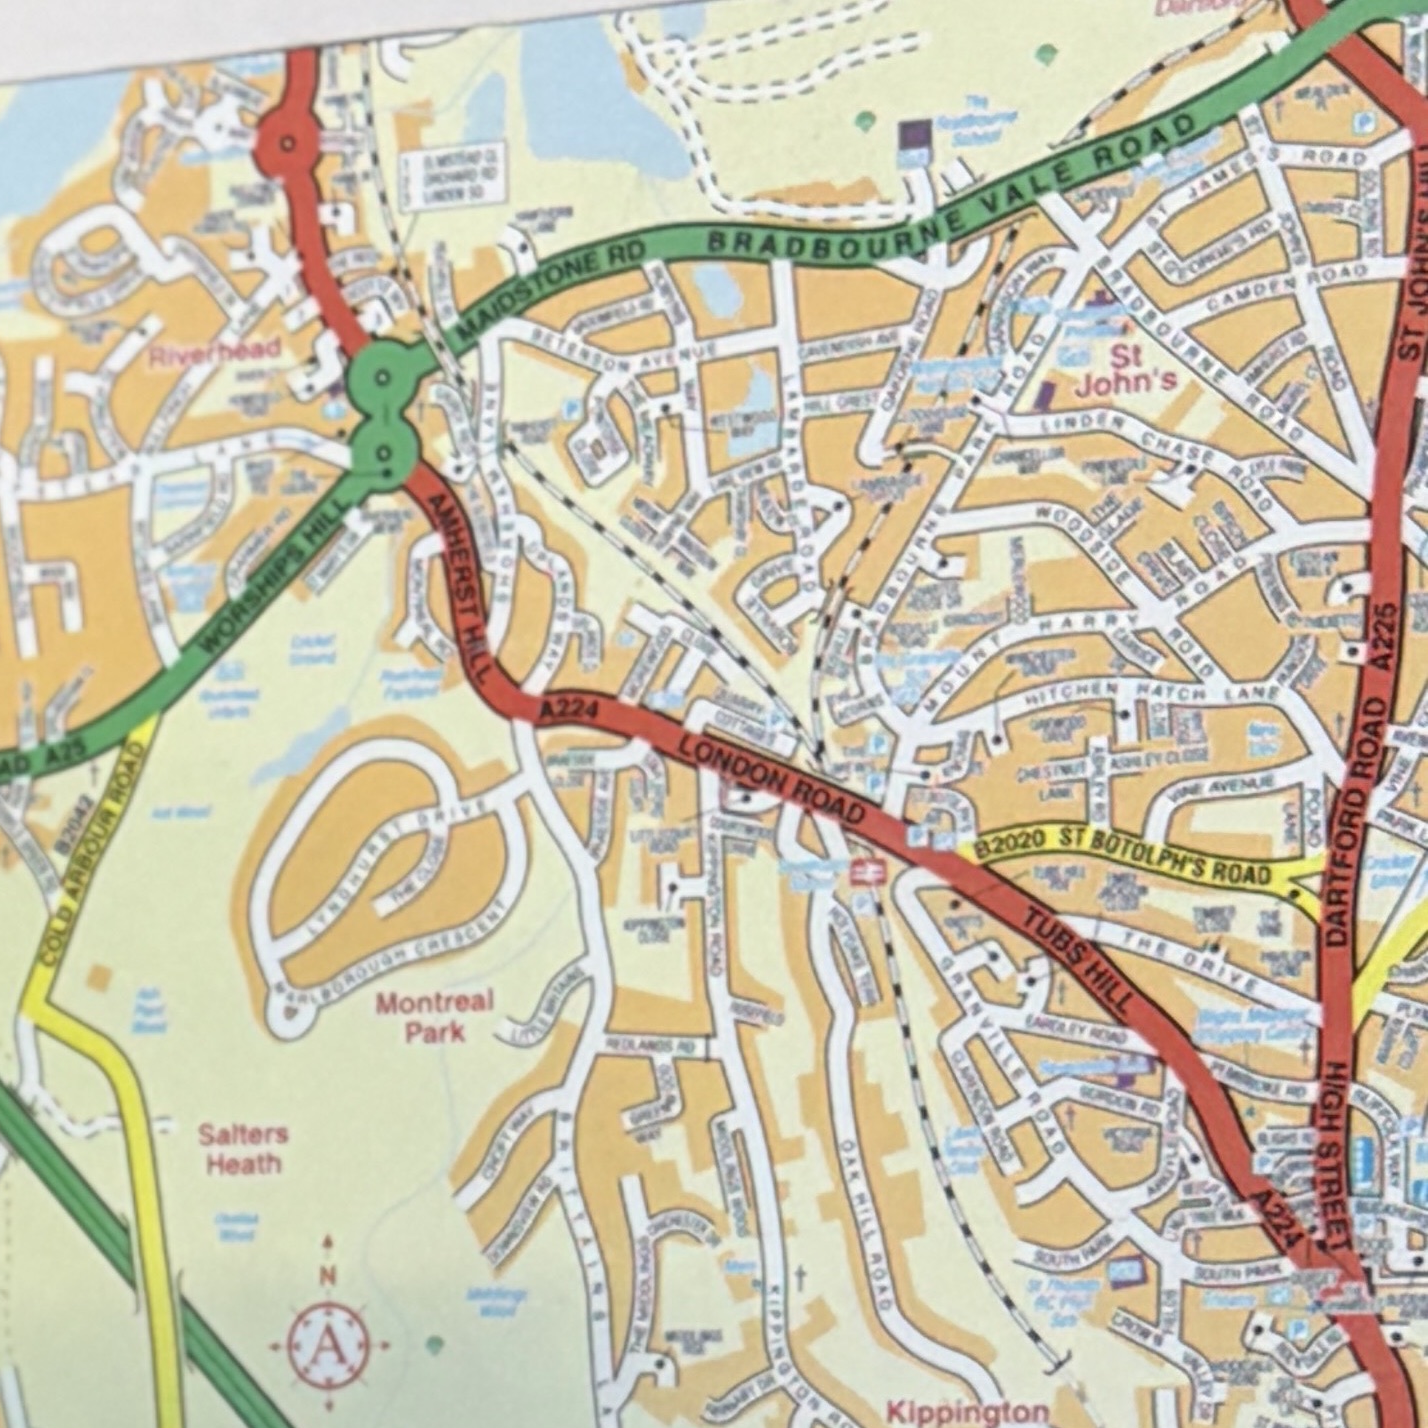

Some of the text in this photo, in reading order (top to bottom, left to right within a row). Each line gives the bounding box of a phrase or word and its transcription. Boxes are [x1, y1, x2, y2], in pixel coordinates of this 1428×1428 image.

[705, 112, 1197, 262] BRADBOURNE VALE ROAD
[1302, 149, 1368, 165] ROAD
[456, 249, 603, 344] MAIDSTONE
[607, 239, 648, 267] RD
[914, 288, 939, 335] ROAD
[1206, 264, 1369, 312] CAMDEN ROAD
[148, 337, 282, 368] Riverhead
[640, 341, 718, 369] AVENUE
[1096, 255, 1228, 384] BRADBOURNE
[1245, 392, 1305, 442] ROAD
[1109, 343, 1143, 369] St
[1321, 345, 1347, 392] ROAD
[1397, 325, 1423, 362] ST
[955, 421, 993, 480] PARK
[1002, 333, 1047, 398] ROAD
[1075, 366, 1179, 397] John's
[1041, 414, 1273, 512] LINDEN CHASE ROAD
[199, 540, 306, 655] WORSHIPS
[303, 498, 350, 548] HILL
[429, 493, 492, 688] AMHERST HILL
[1036, 506, 1214, 678] WOODSIDE ROAD
[924, 633, 1003, 714] MOUNT
[1040, 612, 1138, 632] HARRY
[1177, 555, 1247, 608] ROAD
[1369, 601, 1399, 671] A225
[539, 696, 600, 723] A224
[1025, 682, 1280, 705] HITCHEN HATCH LANE
[44, 738, 88, 767] A25
[677, 734, 867, 826] LONDON ROAD
[1208, 774, 1276, 793] AVENUE
[1324, 696, 1387, 949] DARTFORD ROAD
[39, 740, 145, 968] COLD ARBOUR ROAD
[305, 799, 488, 937] LYNDHURST DRIVE
[974, 826, 1272, 886] B2020 ST BOTOLPH'S ROAD
[272, 898, 507, 1006] MARLBOROUGH CRESCENT
[1022, 905, 1133, 1015] TUBS HILL
[1122, 932, 1258, 996] THE DRIVE
[375, 989, 494, 1015] Montreal
[404, 1018, 466, 1044] Park
[942, 955, 1066, 1155] GRANVILLE ROAD
[1089, 1026, 1128, 1044] ROAD
[198, 1123, 289, 1147] Salters
[205, 1152, 283, 1177] Heath
[1316, 1060, 1353, 1252] HIGH STREET
[840, 1139, 894, 1313] OAK HILL ROAD
[1249, 1188, 1305, 1248] A224
[320, 1265, 336, 1285] N
[309, 1323, 347, 1368] A
[768, 1284, 822, 1412] KIPPINGTON
[885, 1398, 1050, 1428] Kippington
